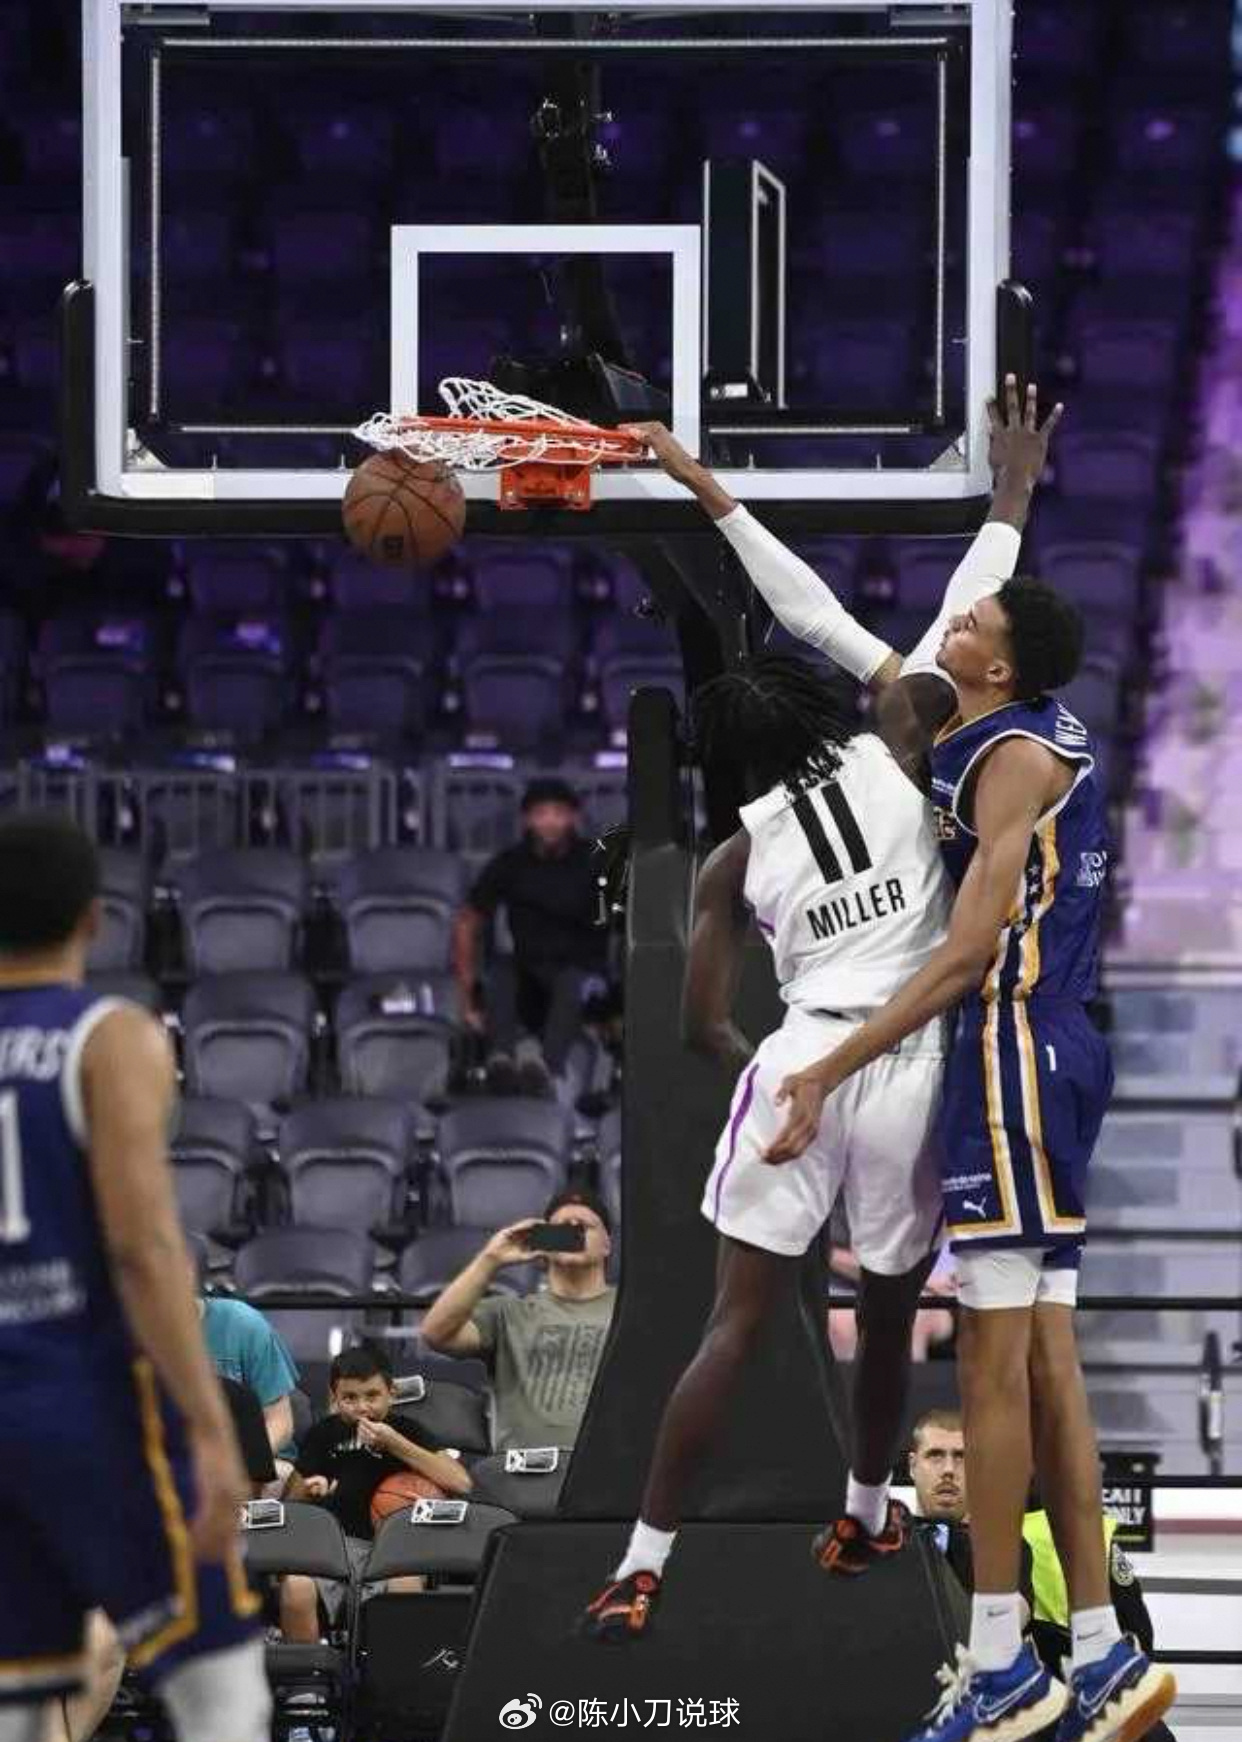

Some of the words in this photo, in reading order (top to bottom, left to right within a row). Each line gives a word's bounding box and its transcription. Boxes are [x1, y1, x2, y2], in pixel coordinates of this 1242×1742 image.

[790, 780, 873, 884] 11
[806, 878, 906, 941] MILLER
[1045, 1044, 1057, 1072] 1
